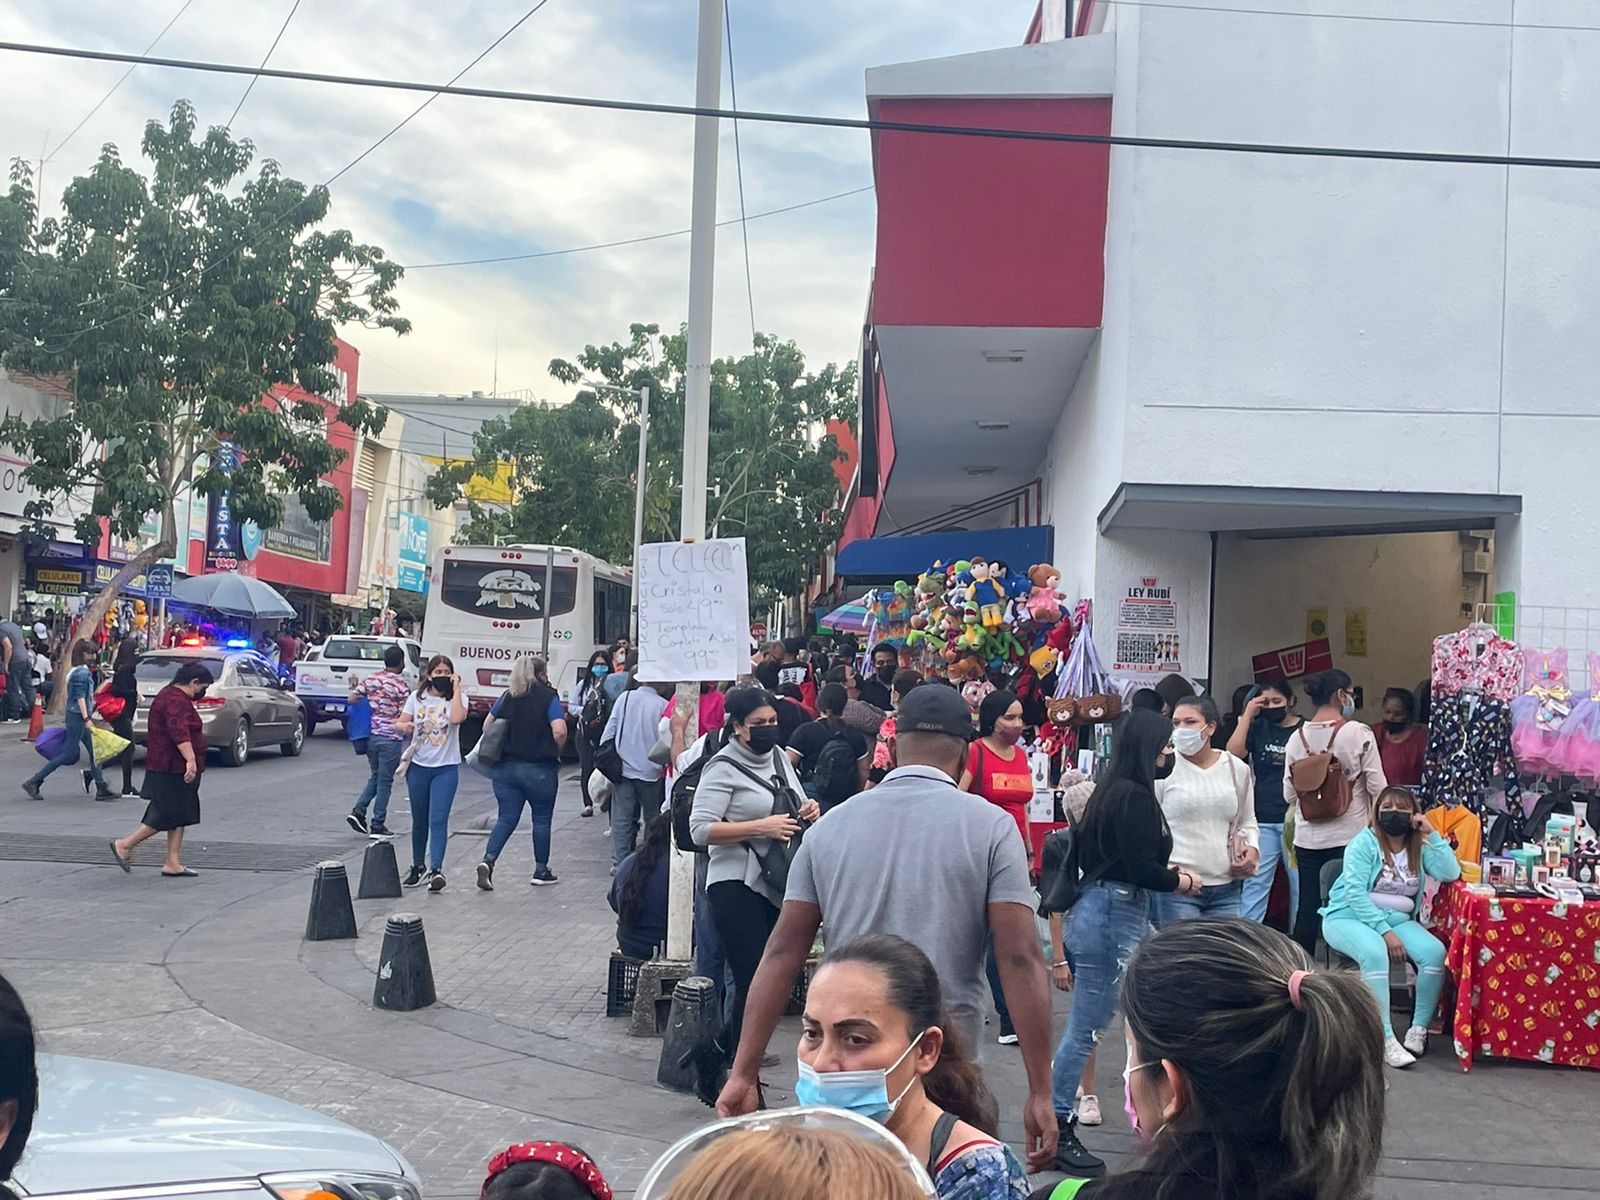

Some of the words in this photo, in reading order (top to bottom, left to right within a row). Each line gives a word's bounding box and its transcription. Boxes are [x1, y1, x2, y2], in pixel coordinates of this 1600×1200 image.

[217, 441, 235, 549] DEISTA
[1128, 587, 1145, 598] LEY
[1147, 586, 1171, 599] RUBÍ
[752, 629, 767, 637] ALTO
[460, 646, 511, 660] BUENOS
